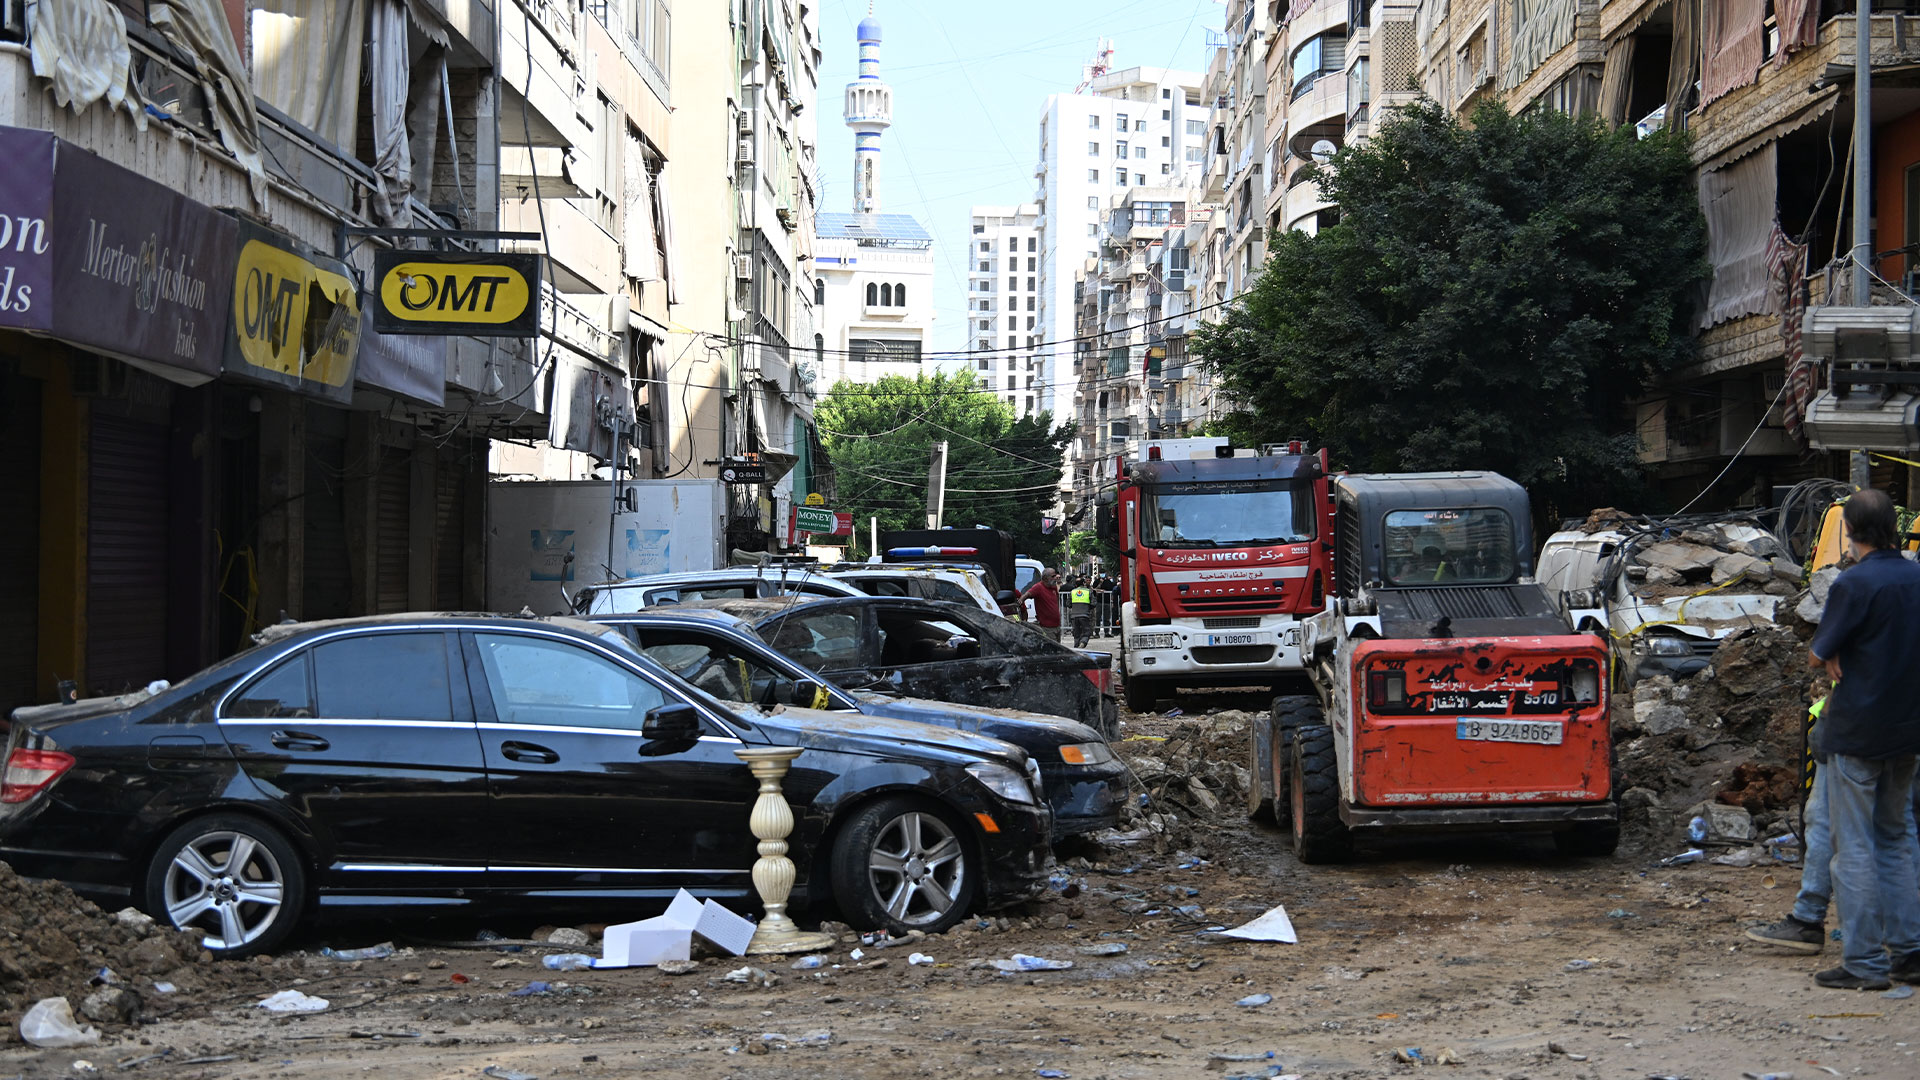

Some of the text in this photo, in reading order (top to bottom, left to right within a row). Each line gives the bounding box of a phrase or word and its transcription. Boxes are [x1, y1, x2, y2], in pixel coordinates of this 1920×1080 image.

[81, 218, 206, 314] Merter fashion
[399, 273, 510, 312] OMT
[244, 266, 300, 348] OMT
[174, 318, 197, 359] kids
[798, 511, 831, 522] MONEY
[1211, 551, 1248, 562] IVECO
[1256, 550, 1284, 561] مركز
[1198, 571, 1229, 581] الضاحية
[1248, 570, 1264, 580] فوج
[1180, 585, 1283, 596] EUROCARGO
[1214, 635, 1252, 645] M 108070
[1501, 676, 1535, 692] بلدية
[1472, 694, 1508, 709] قسم
[1470, 720, 1551, 741] B 924866
